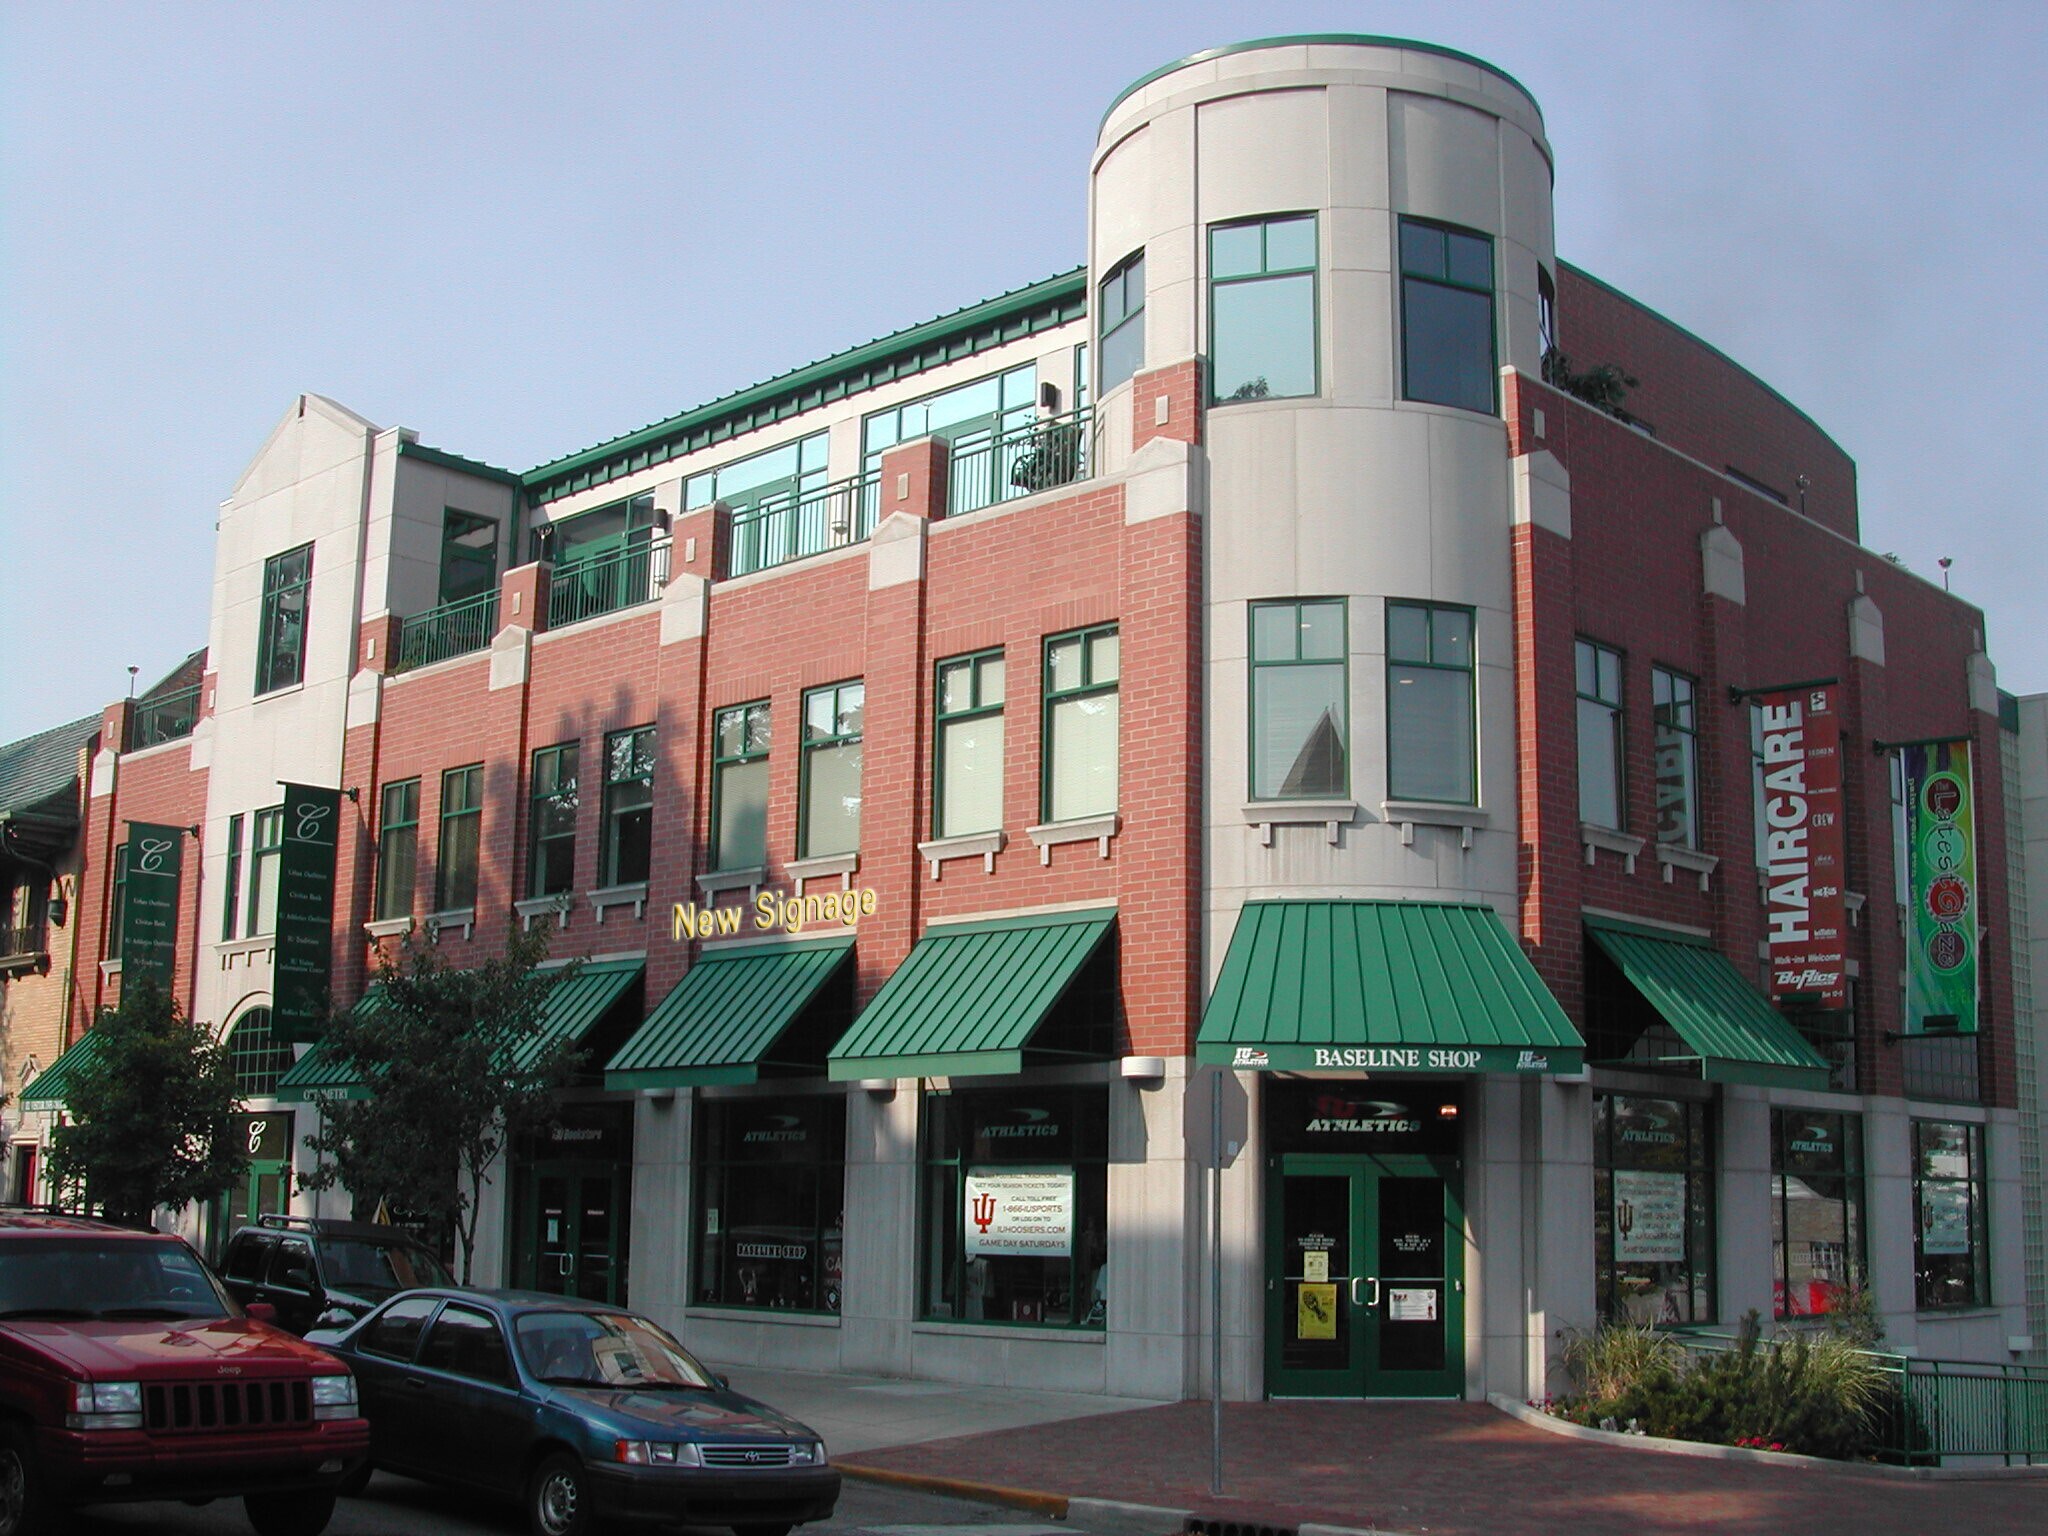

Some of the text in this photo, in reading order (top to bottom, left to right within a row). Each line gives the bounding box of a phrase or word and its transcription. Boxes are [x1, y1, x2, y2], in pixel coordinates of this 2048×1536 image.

[1761, 700, 1809, 942] HAIRCARE
[1808, 953, 1841, 963] Welcome
[1235, 1047, 1253, 1059] IU
[1314, 1048, 1481, 1068] BASELINE SHOP
[981, 1124, 1059, 1138] ATHLETICS
[1306, 1119, 1422, 1132] ATHLETICS
[743, 1130, 807, 1142] ATHLETICS
[1622, 1129, 1676, 1143] ATHLETICS
[1790, 1141, 1833, 1153] ATHLETICS
[979, 1239, 1002, 1247] GAME
[1019, 1240, 1065, 1248] SATURDAYS
[737, 1243, 807, 1259] BASELINE SHOP
[217, 1365, 241, 1375] Jeep
